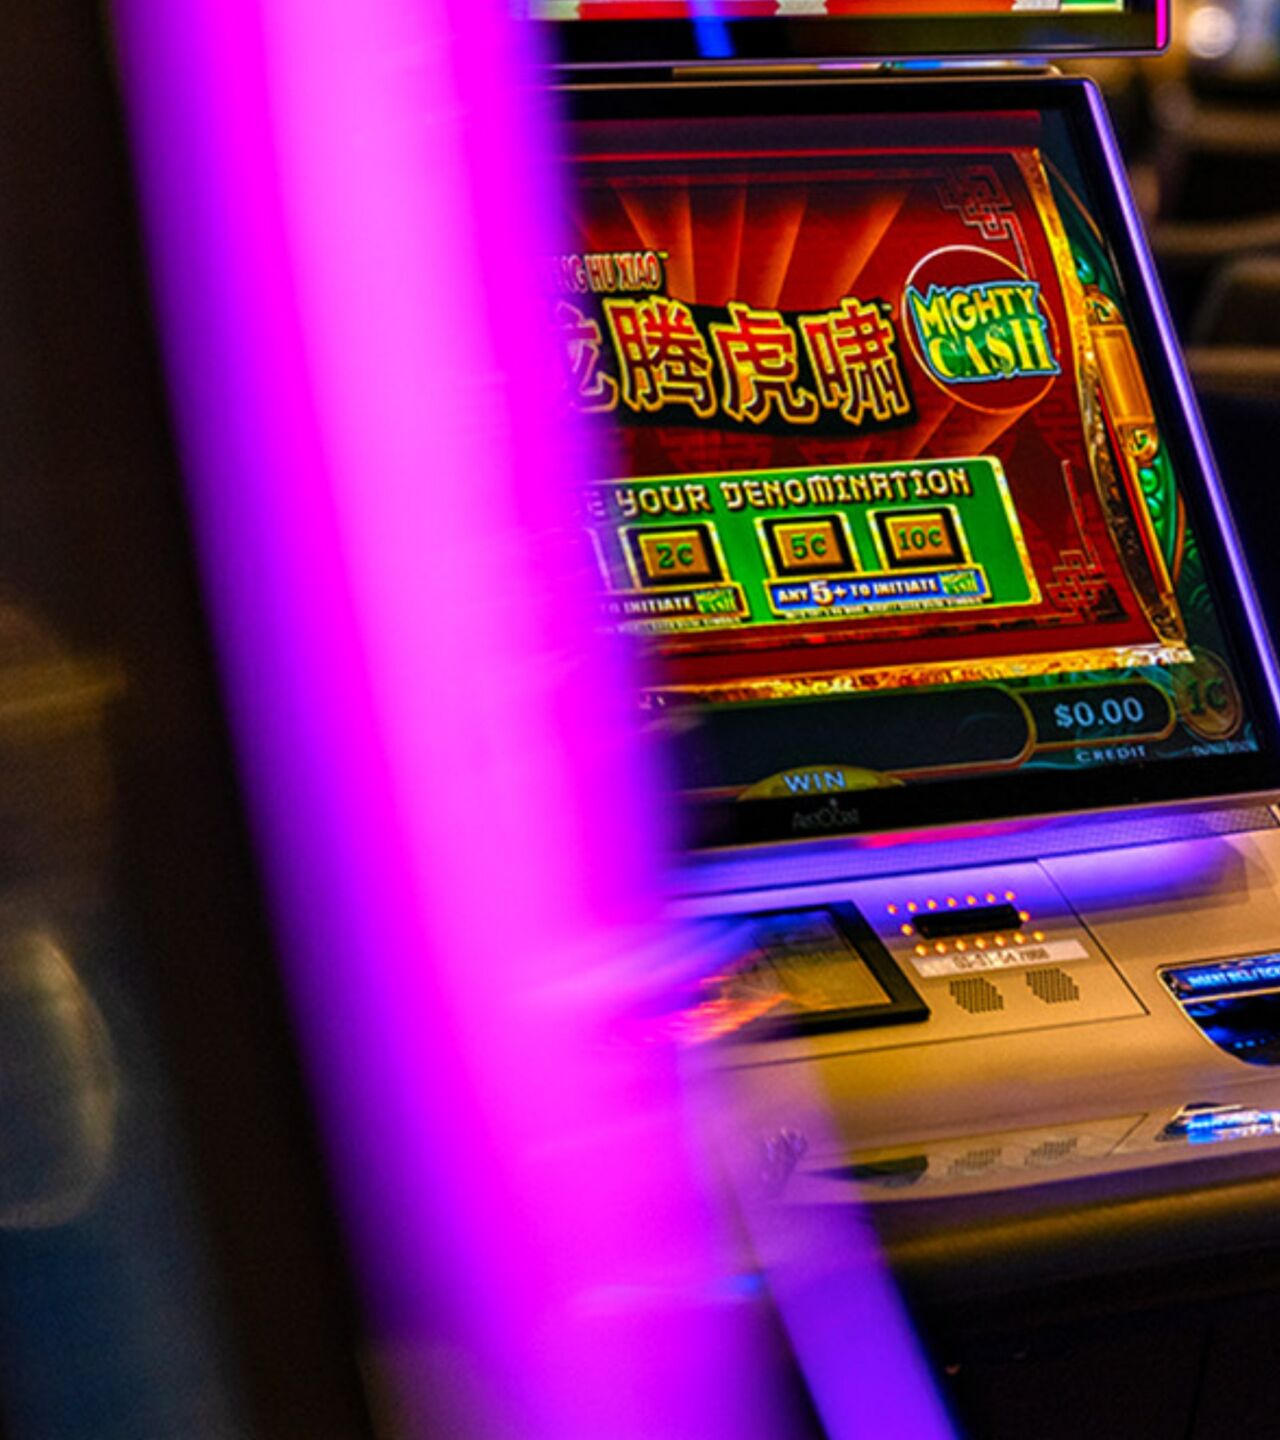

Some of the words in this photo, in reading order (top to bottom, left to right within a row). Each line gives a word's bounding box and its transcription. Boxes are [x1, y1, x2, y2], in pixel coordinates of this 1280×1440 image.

[912, 287, 1034, 341] MIGHTY
[615, 483, 712, 517] YOUR
[719, 468, 973, 509] DENOMINATION
[873, 579, 939, 596] INITIATE
[623, 597, 692, 614] INITIATE
[1054, 697, 1144, 729] $0.00
[1076, 745, 1147, 763] CREDIT
[784, 770, 846, 793] WIN
